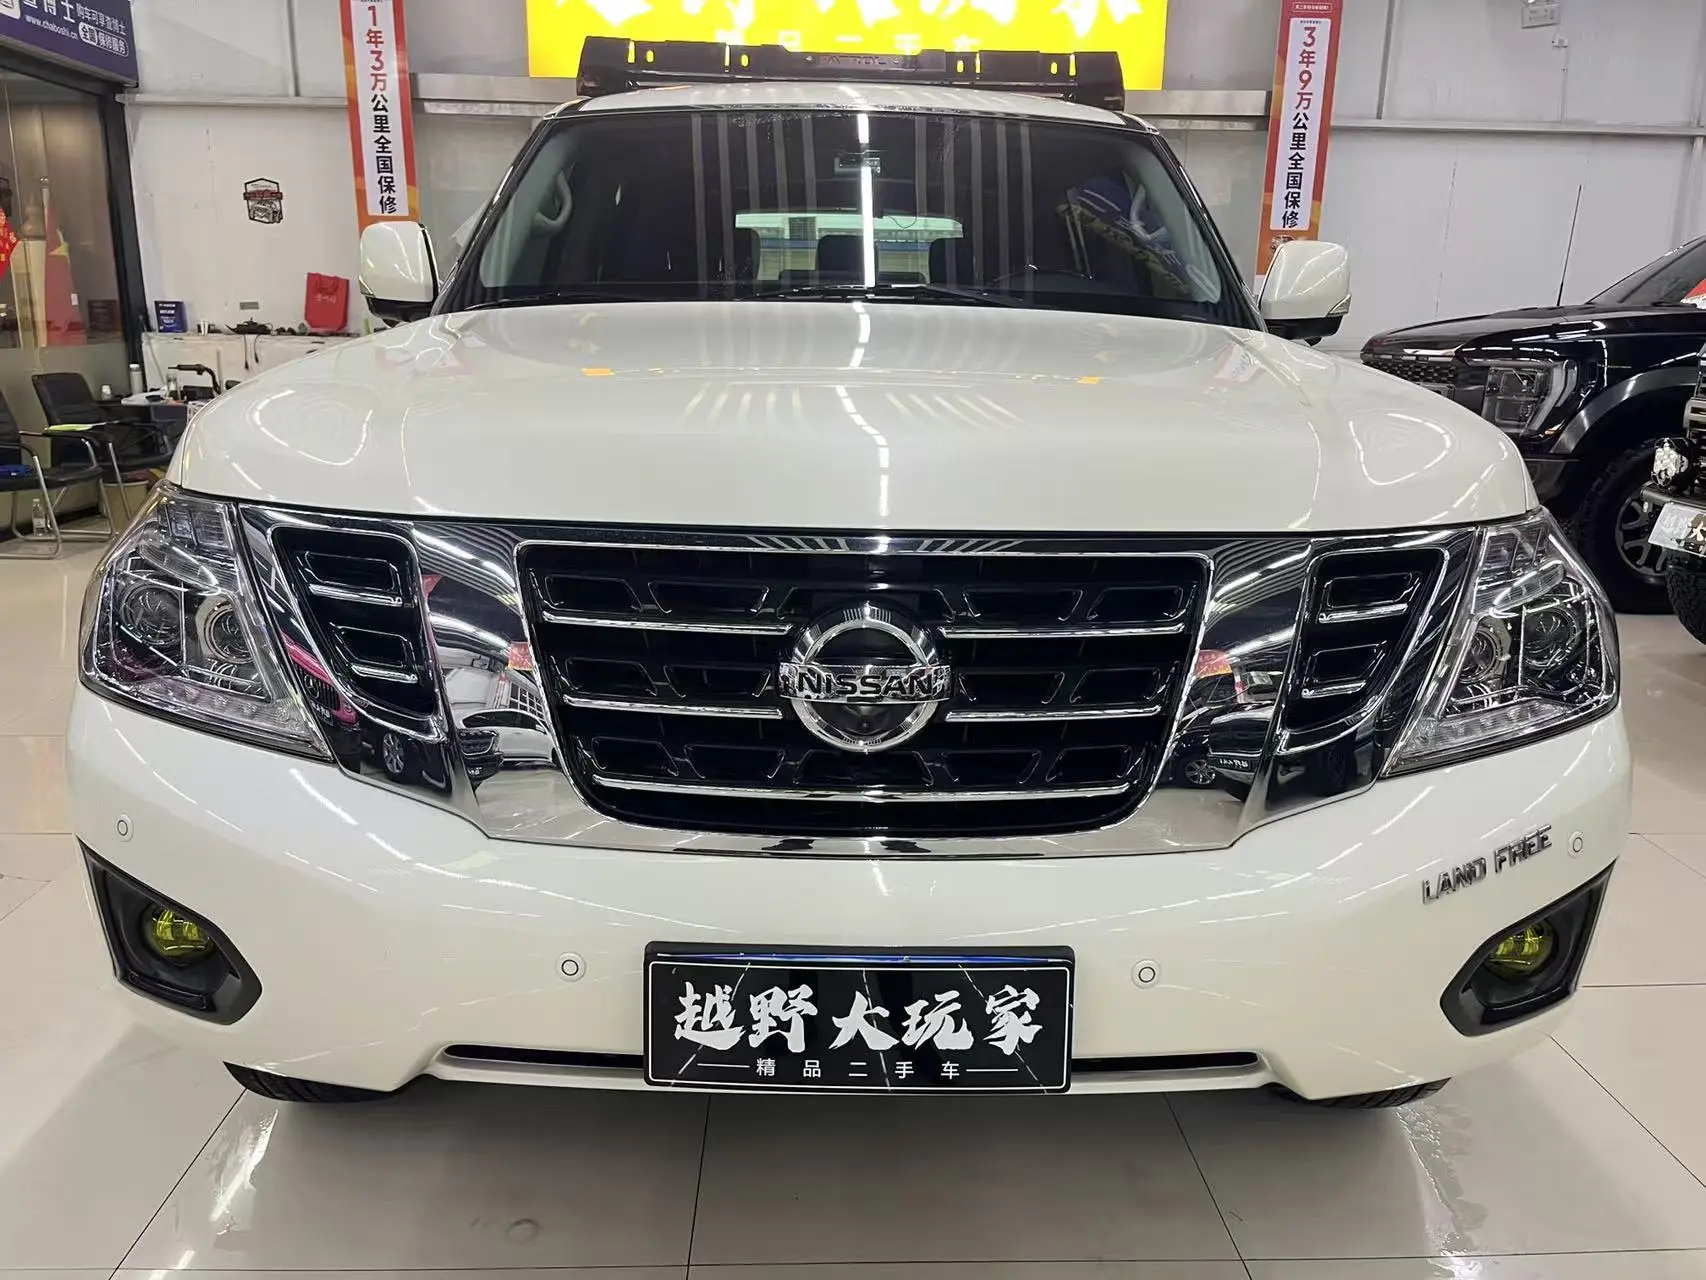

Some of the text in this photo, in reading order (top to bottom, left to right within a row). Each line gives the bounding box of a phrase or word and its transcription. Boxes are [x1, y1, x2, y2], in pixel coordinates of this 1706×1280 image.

[25, 15, 79, 40] www.chaboshi.cn
[365, 5, 397, 215] 1年3万公里全国保修
[1281, 26, 1317, 229] 3年9万公里全国保修
[798, 671, 936, 696] NISSAN
[1422, 824, 1552, 904] LAND FREE
[674, 981, 1043, 1054] 越野大玩家
[756, 1058, 961, 1080] 精品二手车
